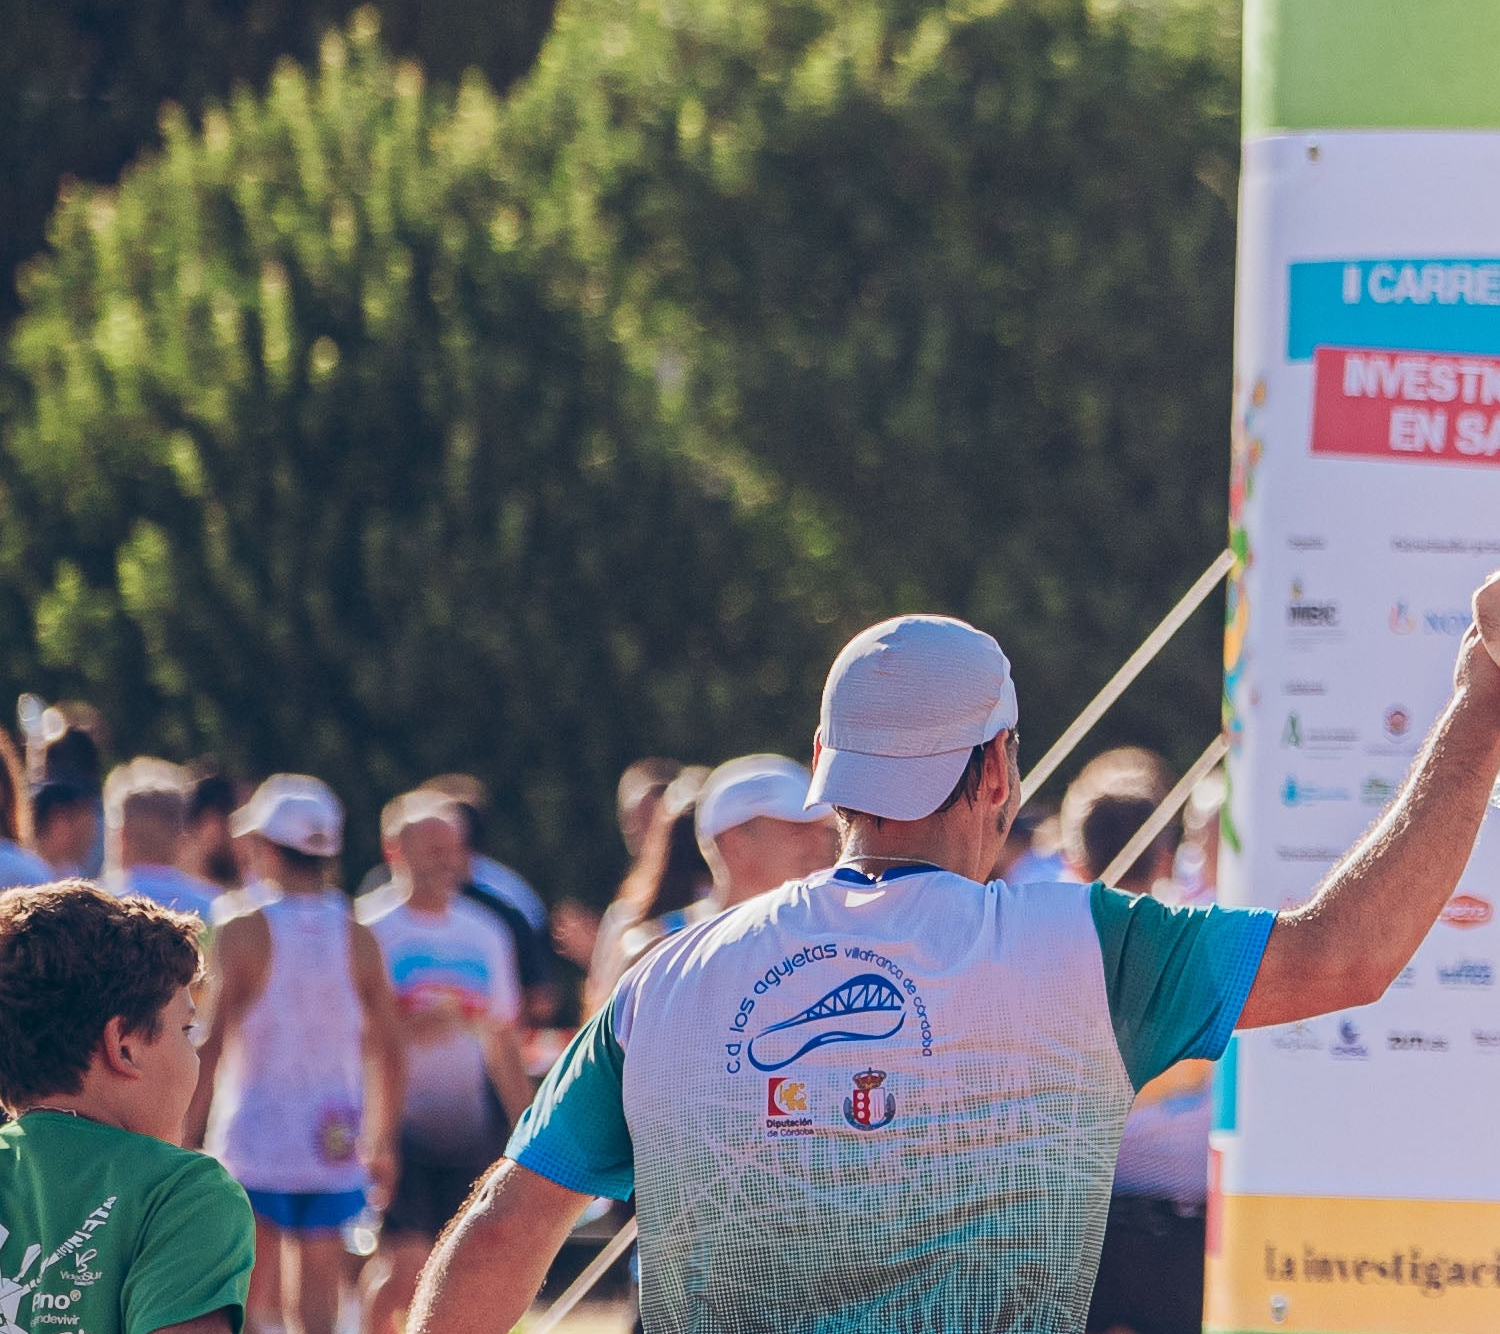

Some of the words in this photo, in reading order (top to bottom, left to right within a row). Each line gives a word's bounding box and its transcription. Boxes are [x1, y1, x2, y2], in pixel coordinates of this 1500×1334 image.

[1388, 405, 1448, 453] EN
[729, 997, 755, 1033] los
[754, 943, 838, 995] agujetas
[844, 946, 904, 981] villafranca
[902, 977, 917, 996] de
[766, 1117, 813, 1129] Diputación
